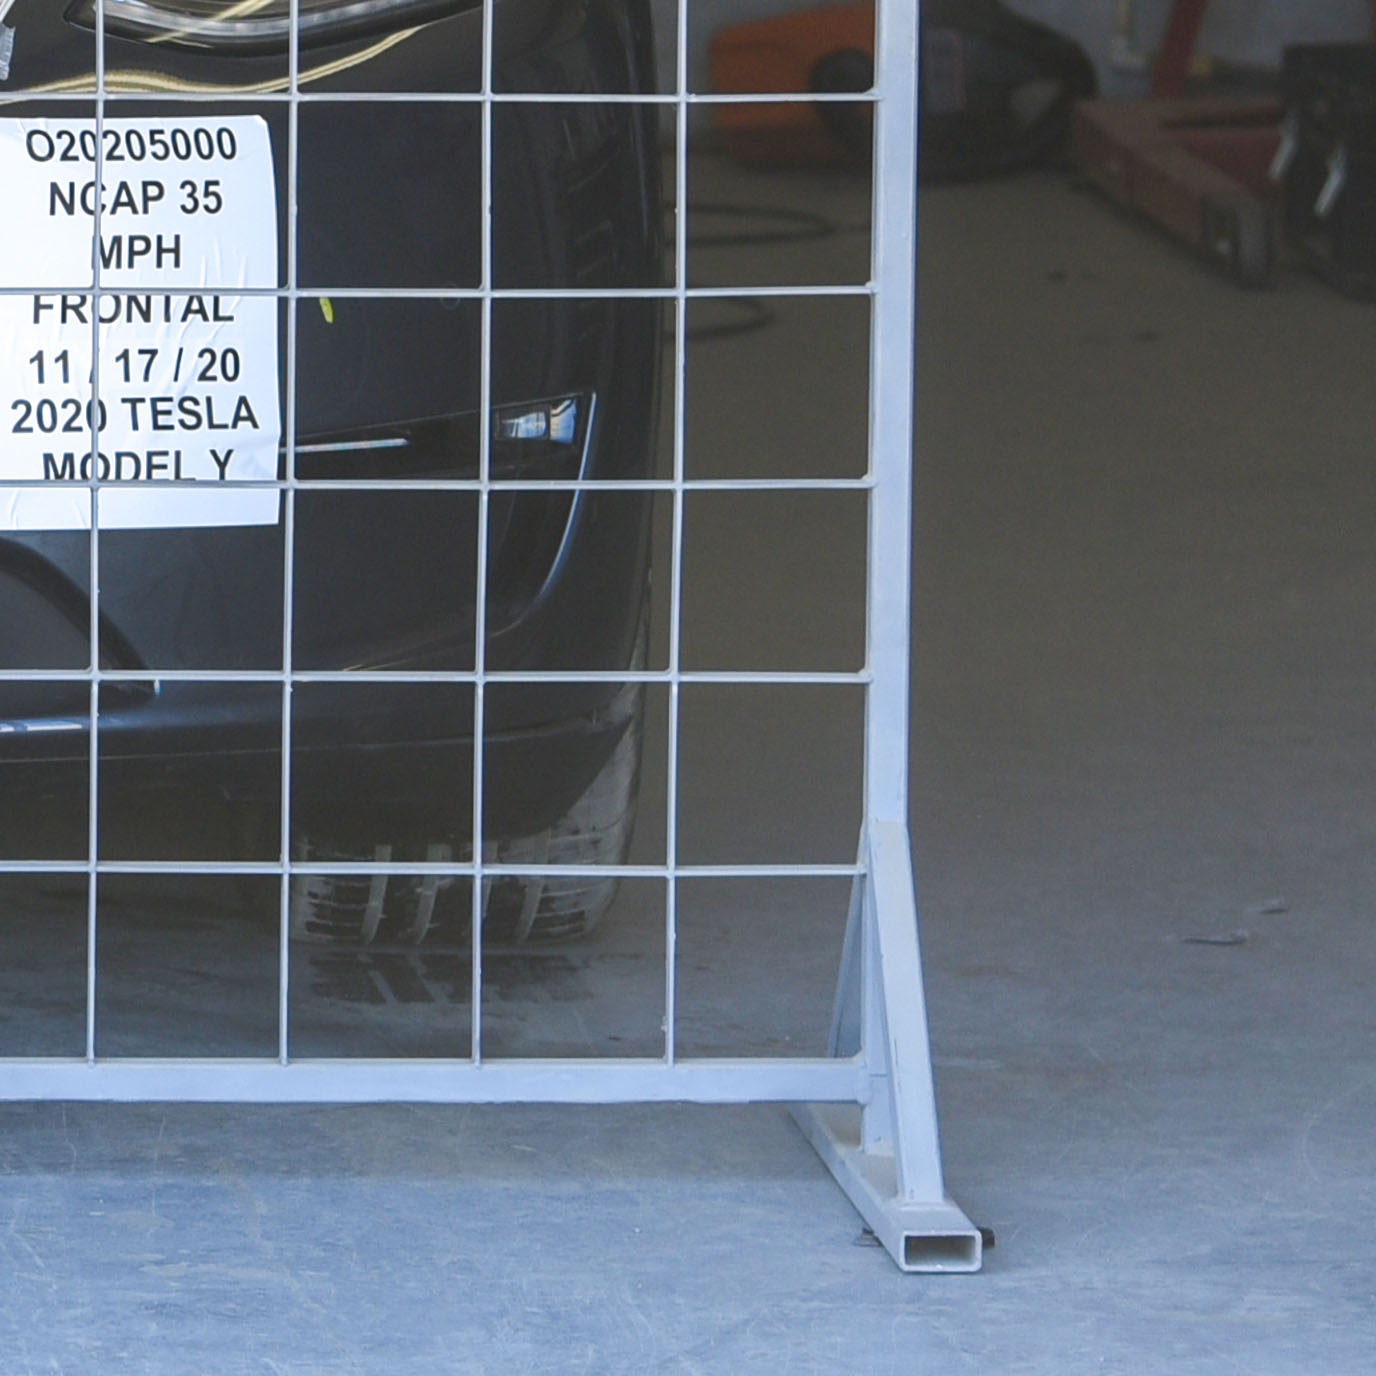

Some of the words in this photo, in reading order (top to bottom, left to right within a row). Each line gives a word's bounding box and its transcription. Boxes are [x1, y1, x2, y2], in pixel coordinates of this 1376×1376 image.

[49, 180, 165, 216] NCAP
[179, 180, 223, 214] 35
[92, 234, 182, 270] MPH
[29, 349, 69, 384] 11
[115, 348, 159, 383] 17
[197, 348, 240, 382] 20
[10, 399, 107, 434] 2020
[121, 396, 260, 431] TESLA
[43, 450, 196, 481] MODEL
[210, 449, 234, 481] Y
